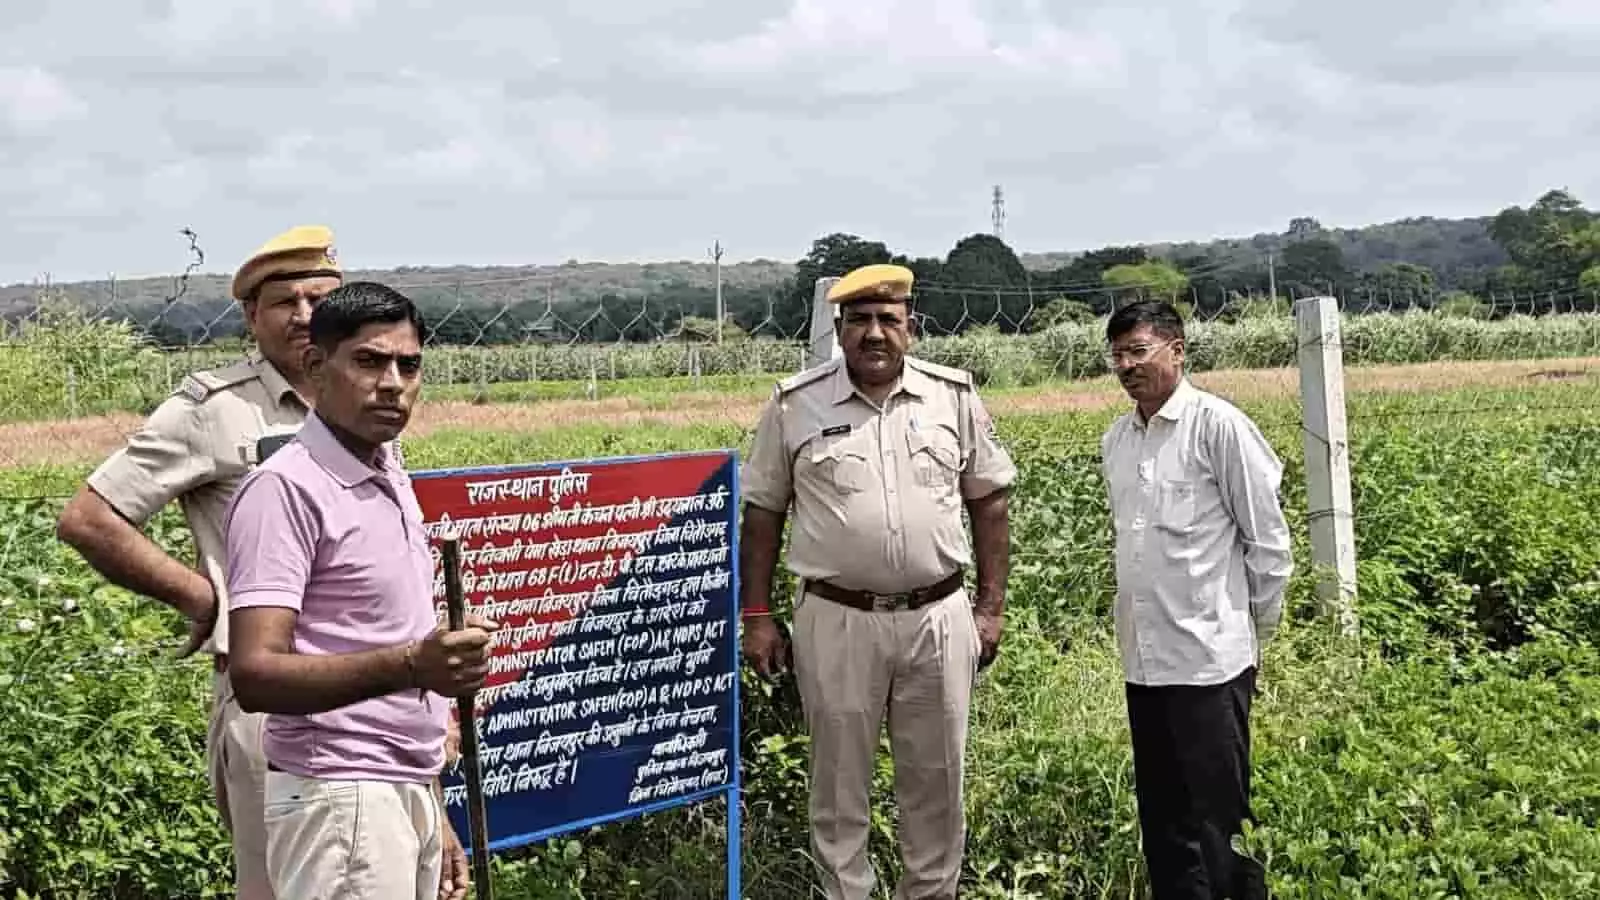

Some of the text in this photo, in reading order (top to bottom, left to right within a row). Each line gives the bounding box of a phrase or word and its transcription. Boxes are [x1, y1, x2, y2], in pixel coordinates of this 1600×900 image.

[465, 467, 592, 505] राजस्थान पुलिस
[522, 513, 541, 532] 06
[705, 485, 730, 510] उर्फ
[511, 617, 550, 648] पुलिस
[703, 620, 728, 641] ACT
[487, 701, 577, 736] ADMINSTRATOR
[713, 672, 735, 692] ACT
[480, 741, 504, 767] लिस
